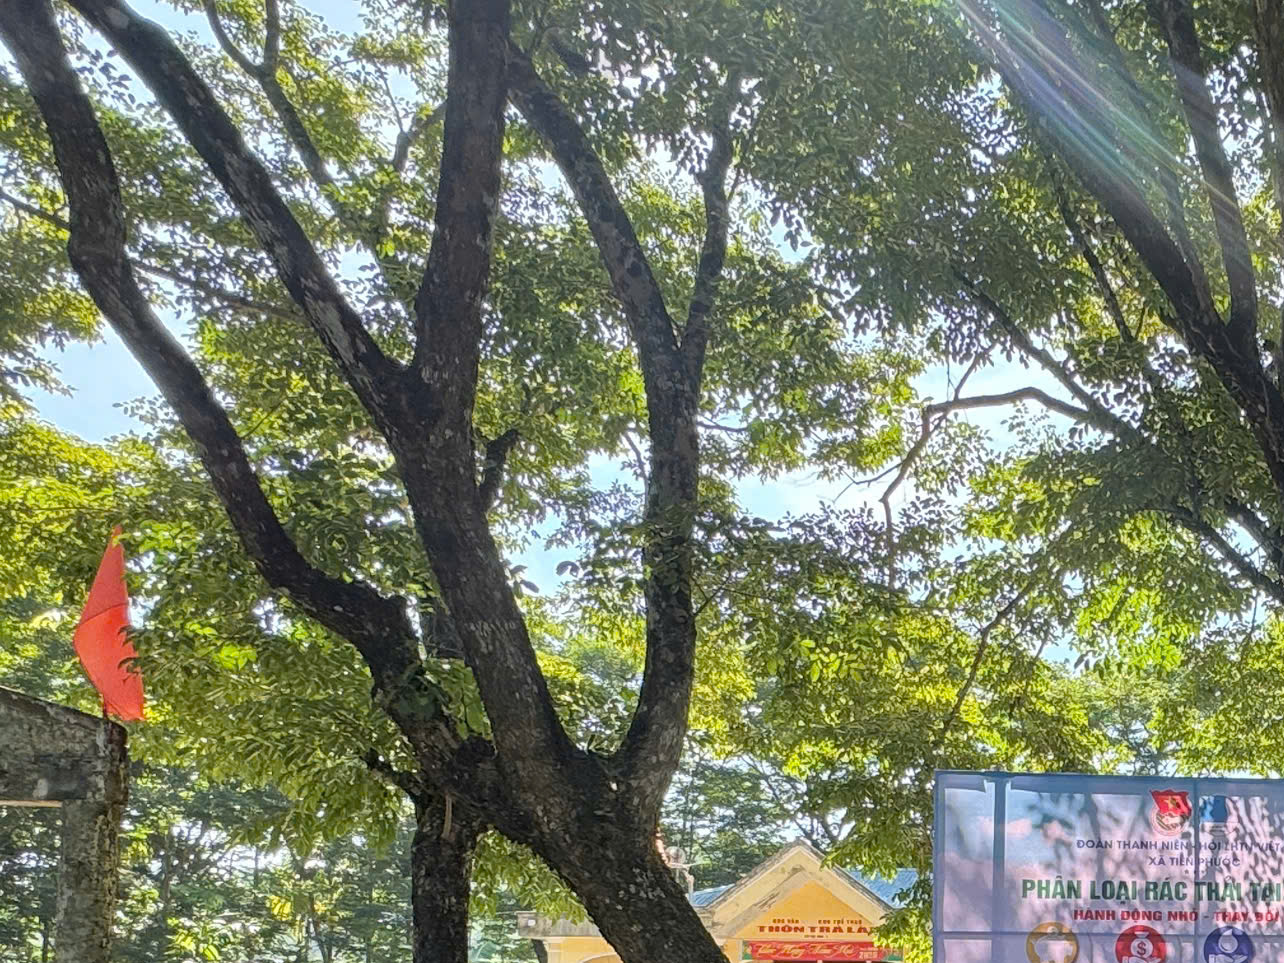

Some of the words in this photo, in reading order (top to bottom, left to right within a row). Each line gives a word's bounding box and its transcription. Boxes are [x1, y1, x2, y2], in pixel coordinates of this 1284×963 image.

[1076, 838, 1113, 849] ĐOÀN
[1117, 840, 1157, 850] THANH
[1161, 838, 1189, 851] NIÊN
[1149, 855, 1166, 866] XÃ
[1170, 854, 1194, 867] TIÊN
[1199, 855, 1240, 867] PHƯỚC
[1021, 875, 1082, 900] PHÂN
[1090, 880, 1137, 905] LOẠI
[1145, 877, 1188, 901] RÁC
[1195, 875, 1242, 902] THẢI
[1250, 882, 1281, 907] TẠI
[1074, 906, 1116, 921] HÀNH
[1121, 908, 1163, 923] ĐỘNG
[1168, 907, 1198, 922] NHỎ
[1215, 911, 1249, 922] THAY
[758, 924, 805, 933] THÔN
